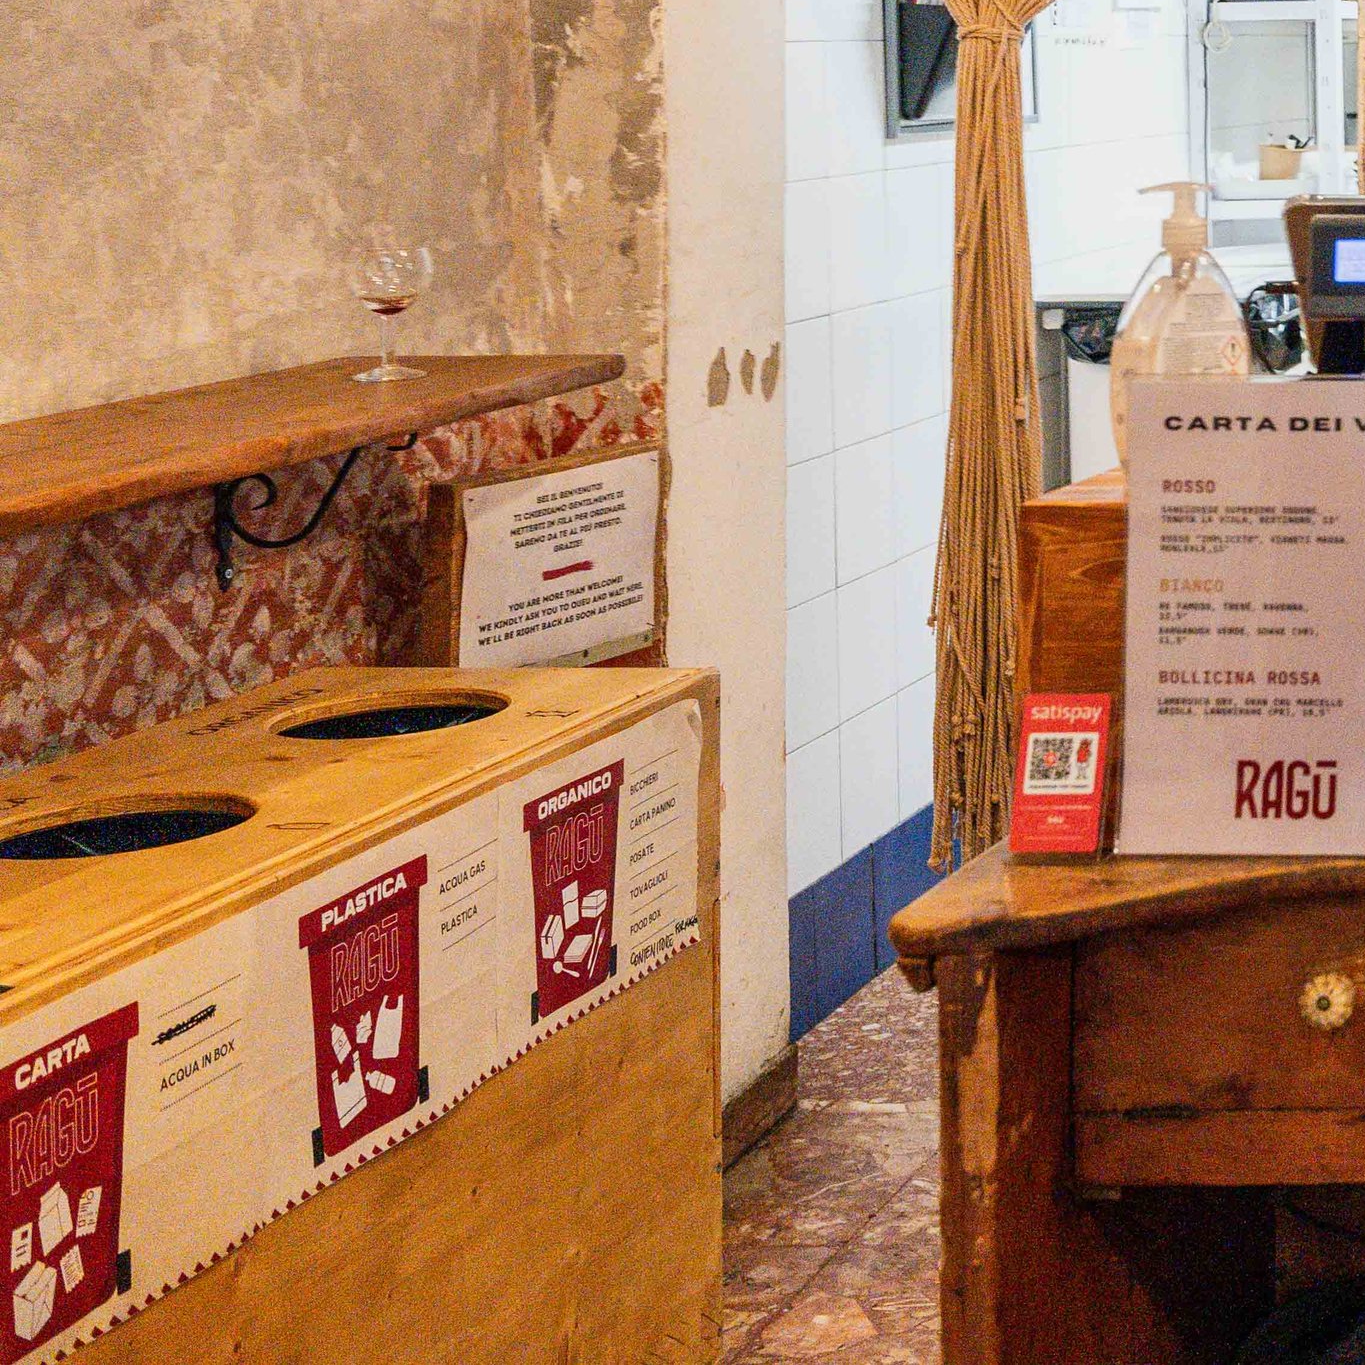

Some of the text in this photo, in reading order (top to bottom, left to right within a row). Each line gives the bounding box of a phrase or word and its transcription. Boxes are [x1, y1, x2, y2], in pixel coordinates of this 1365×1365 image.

[1164, 416, 1276, 432] CARTA
[1289, 417, 1342, 432] DEI
[1162, 479, 1216, 494] ROSSO
[575, 512, 588, 522] PER
[509, 602, 525, 613] YOU
[526, 598, 541, 608] ARE
[542, 592, 564, 604] MORE
[565, 585, 586, 598] THAN
[1159, 578, 1224, 593] BIANCO
[479, 623, 492, 633] WE
[494, 615, 523, 630] KINDLY
[525, 611, 540, 622] ASK
[541, 607, 558, 618] YOU
[560, 603, 569, 613] TO
[592, 593, 607, 604] AND
[609, 587, 625, 598] WAIT
[478, 606, 607, 647] WE'LL BE RIGHT BACK AS SOON AS
[1158, 671, 1321, 685] BOLLICINA ROSSA
[1031, 704, 1103, 725] satispay
[537, 771, 612, 820] ORGANICO
[629, 771, 659, 796] BICCHIERI
[629, 797, 676, 831] CARTA PANINO
[629, 842, 655, 866] POSATE
[439, 860, 487, 895] ACQUA GAS
[630, 870, 668, 900] TOVAGLIOLI
[321, 872, 407, 932] PLASTICA
[441, 904, 478, 935] PLASTICA
[630, 909, 661, 936] FOOD BOX
[14, 1033, 91, 1091] CARTA
[160, 1038, 236, 1092] ACQUA IN BOX
